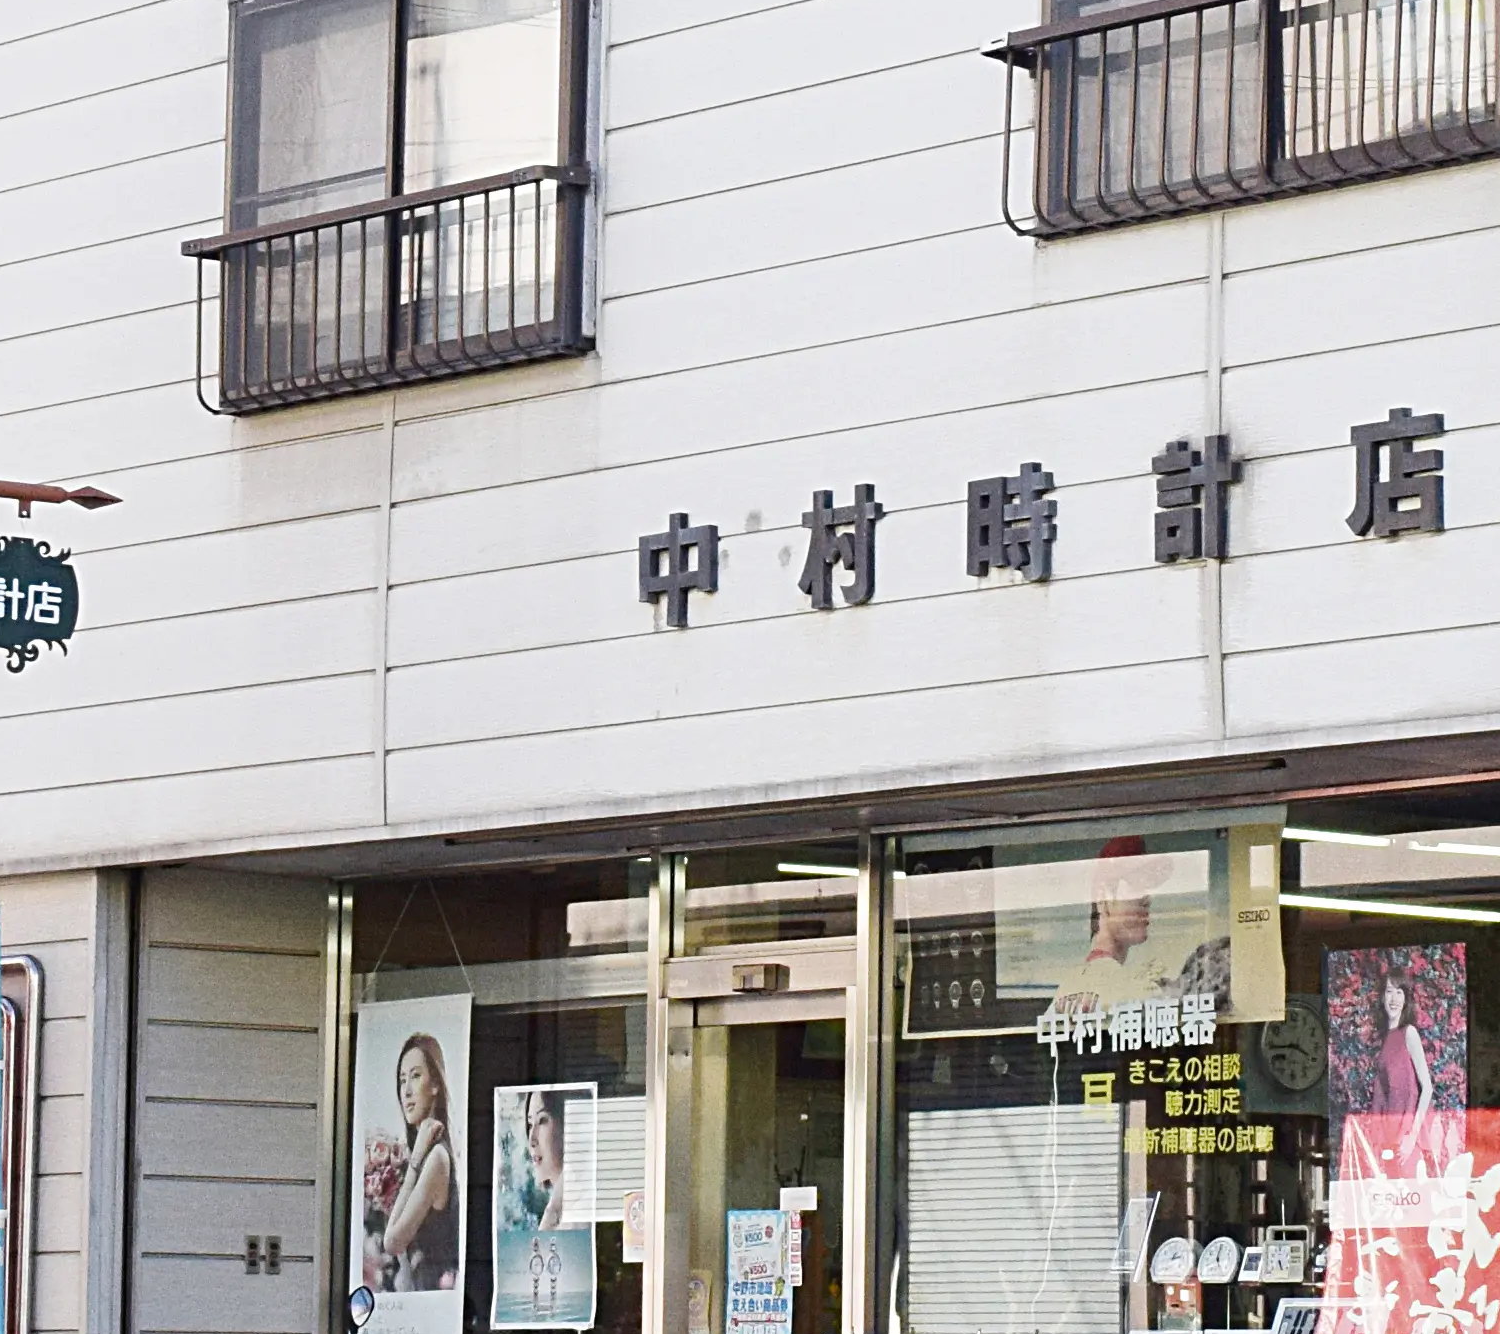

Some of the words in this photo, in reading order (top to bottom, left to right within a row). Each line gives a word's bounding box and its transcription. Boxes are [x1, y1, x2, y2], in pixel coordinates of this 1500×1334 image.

[638, 407, 1445, 628] 中村時計店
[1237, 909, 1271, 923] SEIKO
[1037, 992, 1217, 1058] 中村補聴器
[1128, 1053, 1241, 1085] きこえの相談
[1165, 1087, 1241, 1117] 聴力測定
[1124, 1125, 1274, 1155] 最新補聴器の試聴
